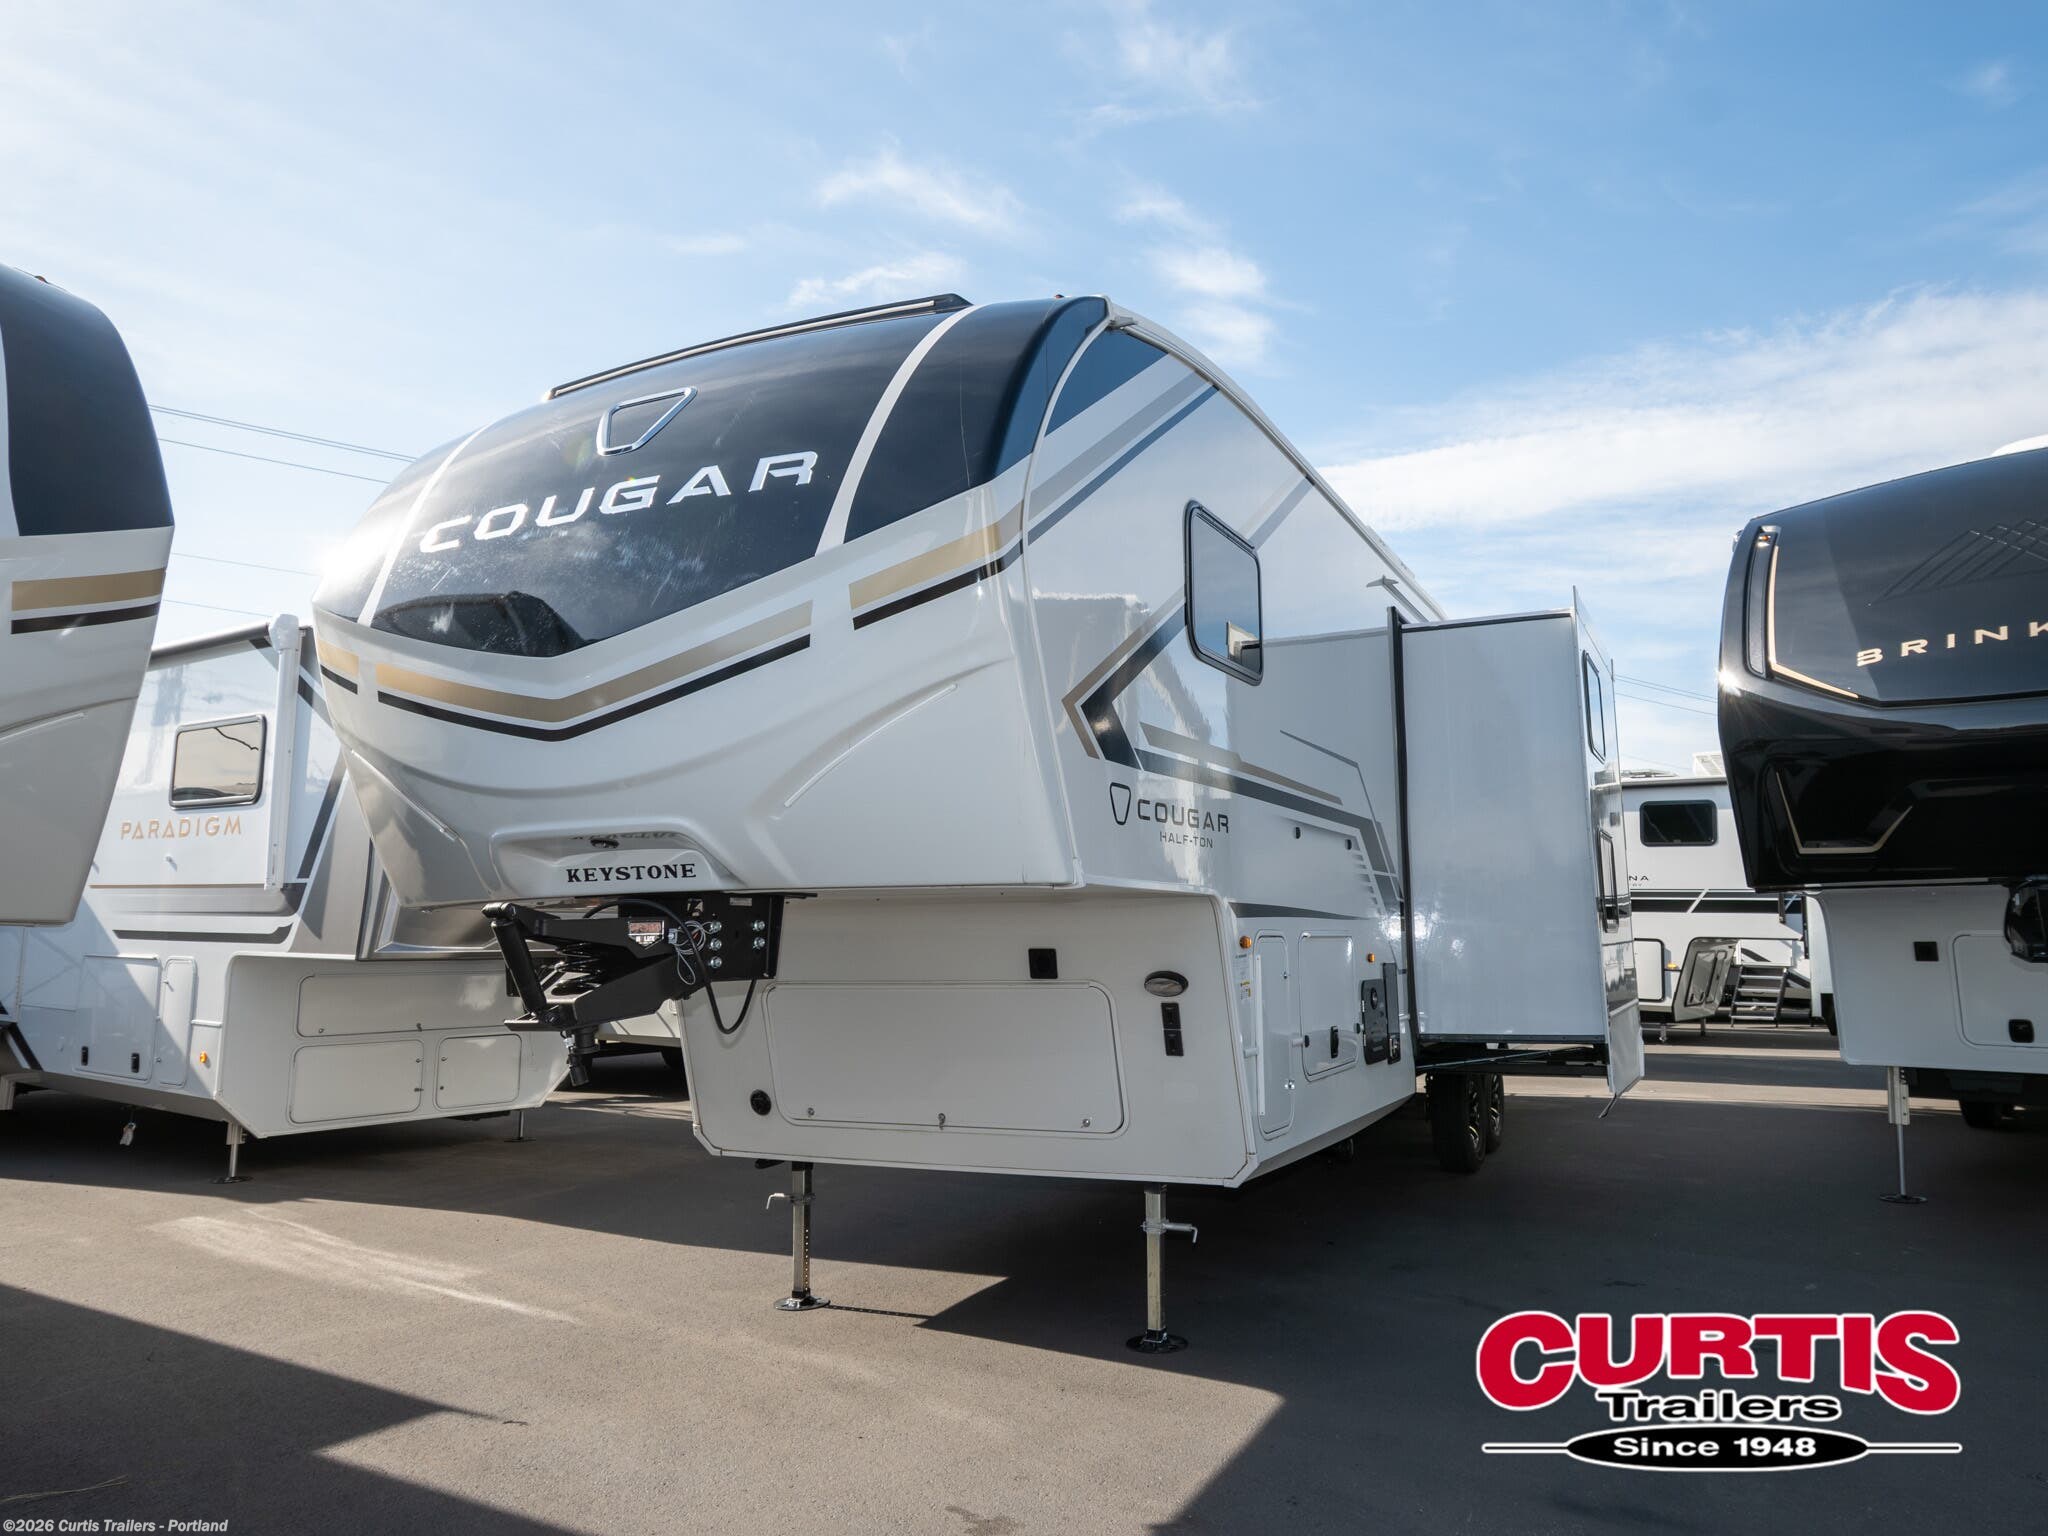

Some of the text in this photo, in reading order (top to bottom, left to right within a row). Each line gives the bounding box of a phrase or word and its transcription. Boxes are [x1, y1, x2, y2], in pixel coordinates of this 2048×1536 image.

[419, 450, 818, 554] COUGAR
[120, 815, 241, 840] PARADIGM
[1137, 798, 1229, 834] COUGAR
[1159, 831, 1214, 849] HALF-TON
[566, 863, 697, 883] KEYSTONE
